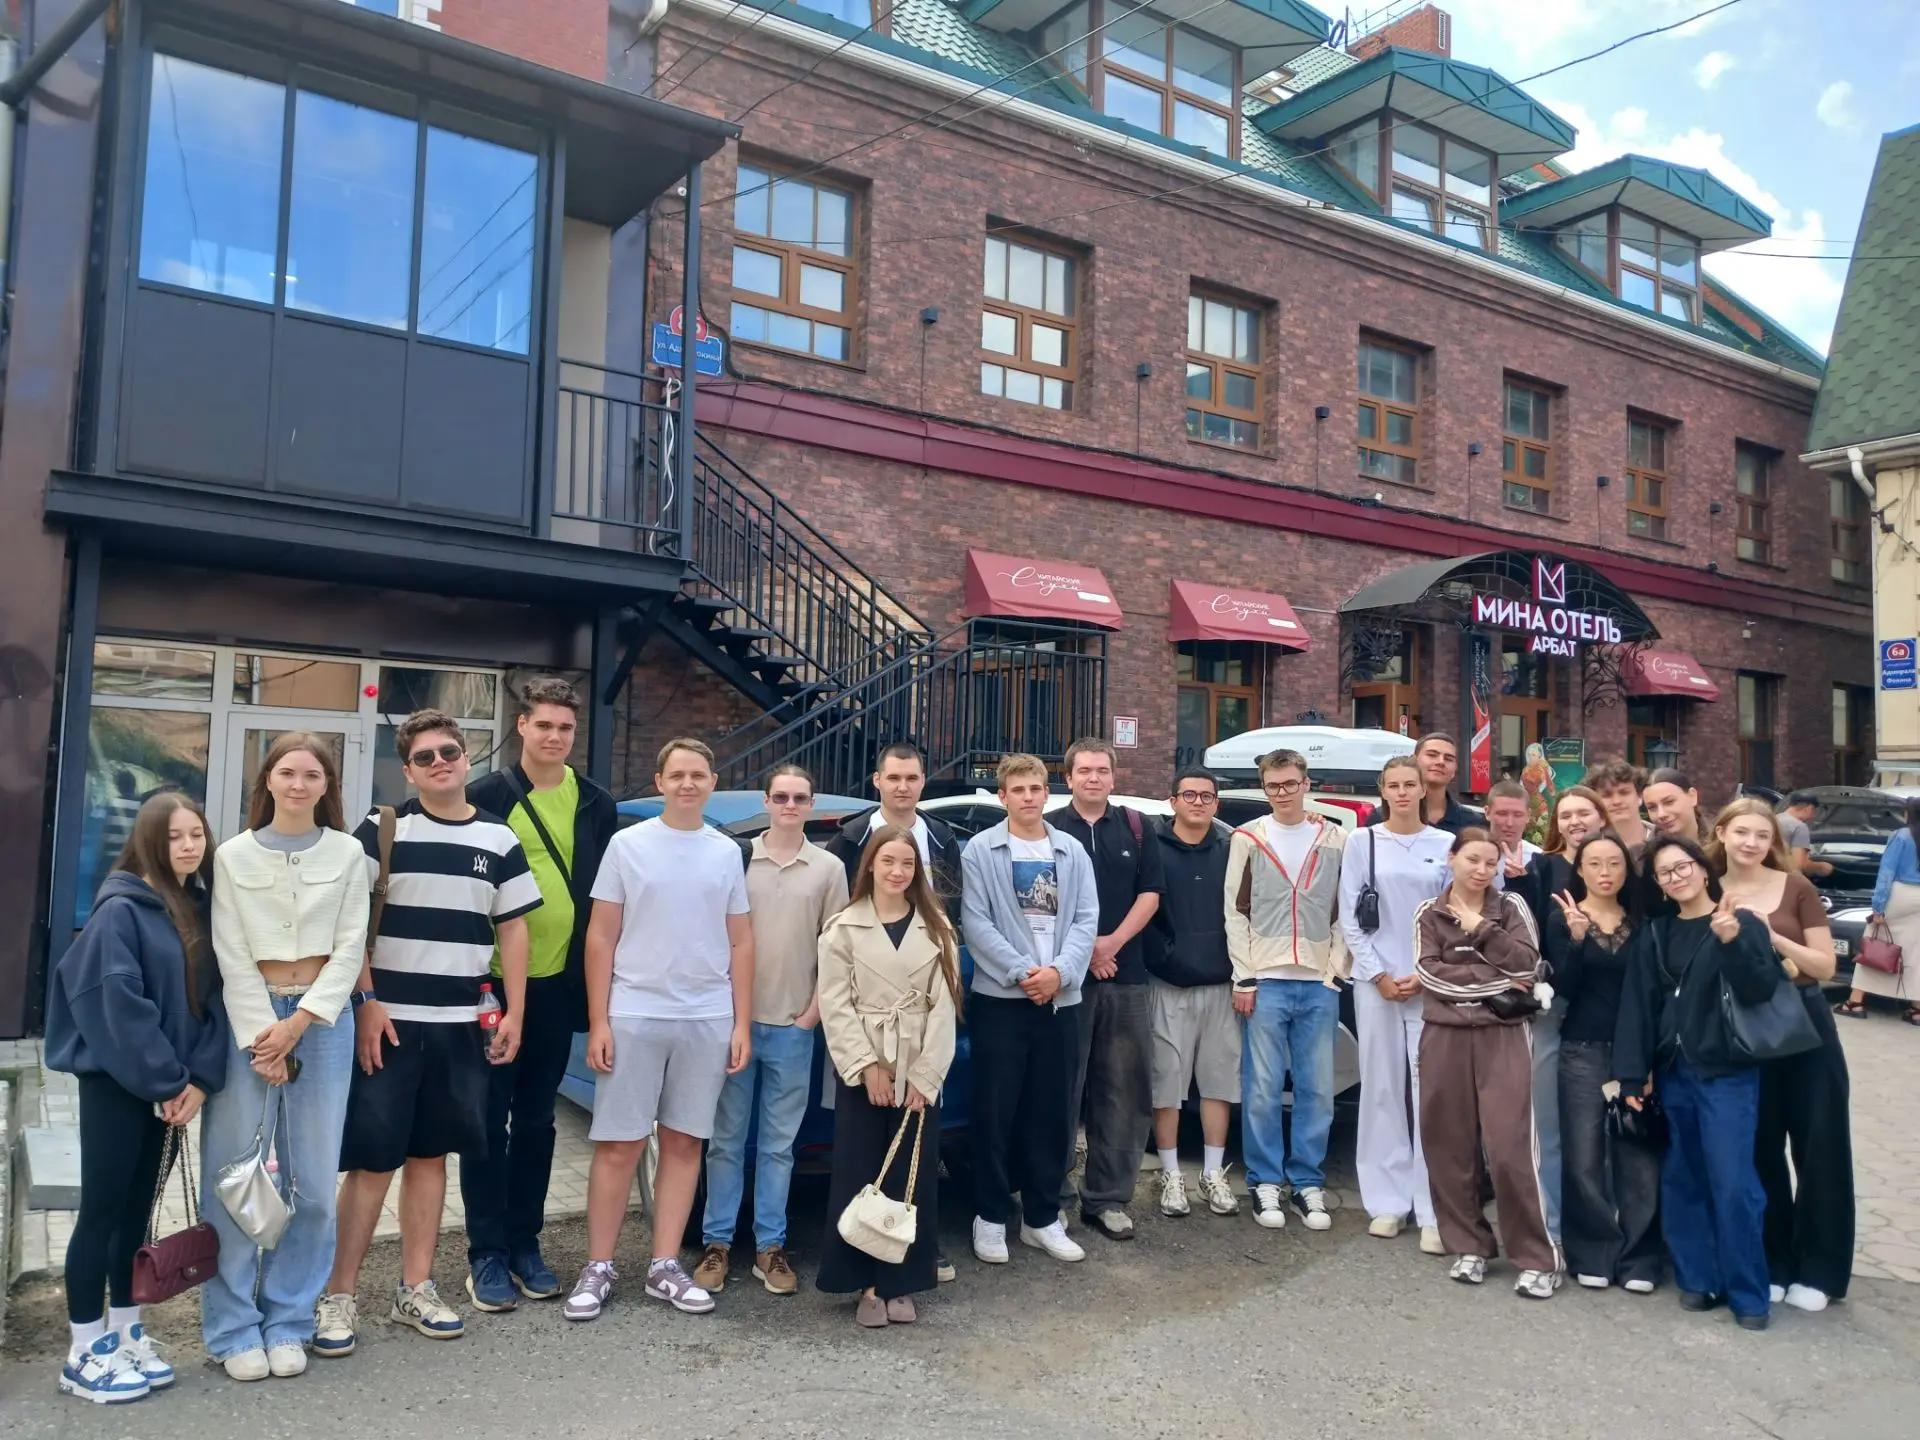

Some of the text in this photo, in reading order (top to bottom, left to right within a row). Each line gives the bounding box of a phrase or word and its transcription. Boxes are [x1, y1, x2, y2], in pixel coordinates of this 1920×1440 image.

[1477, 595, 1622, 643] МИНА ОТЕЛЬ
[1532, 635, 1577, 657] АРБАТ
